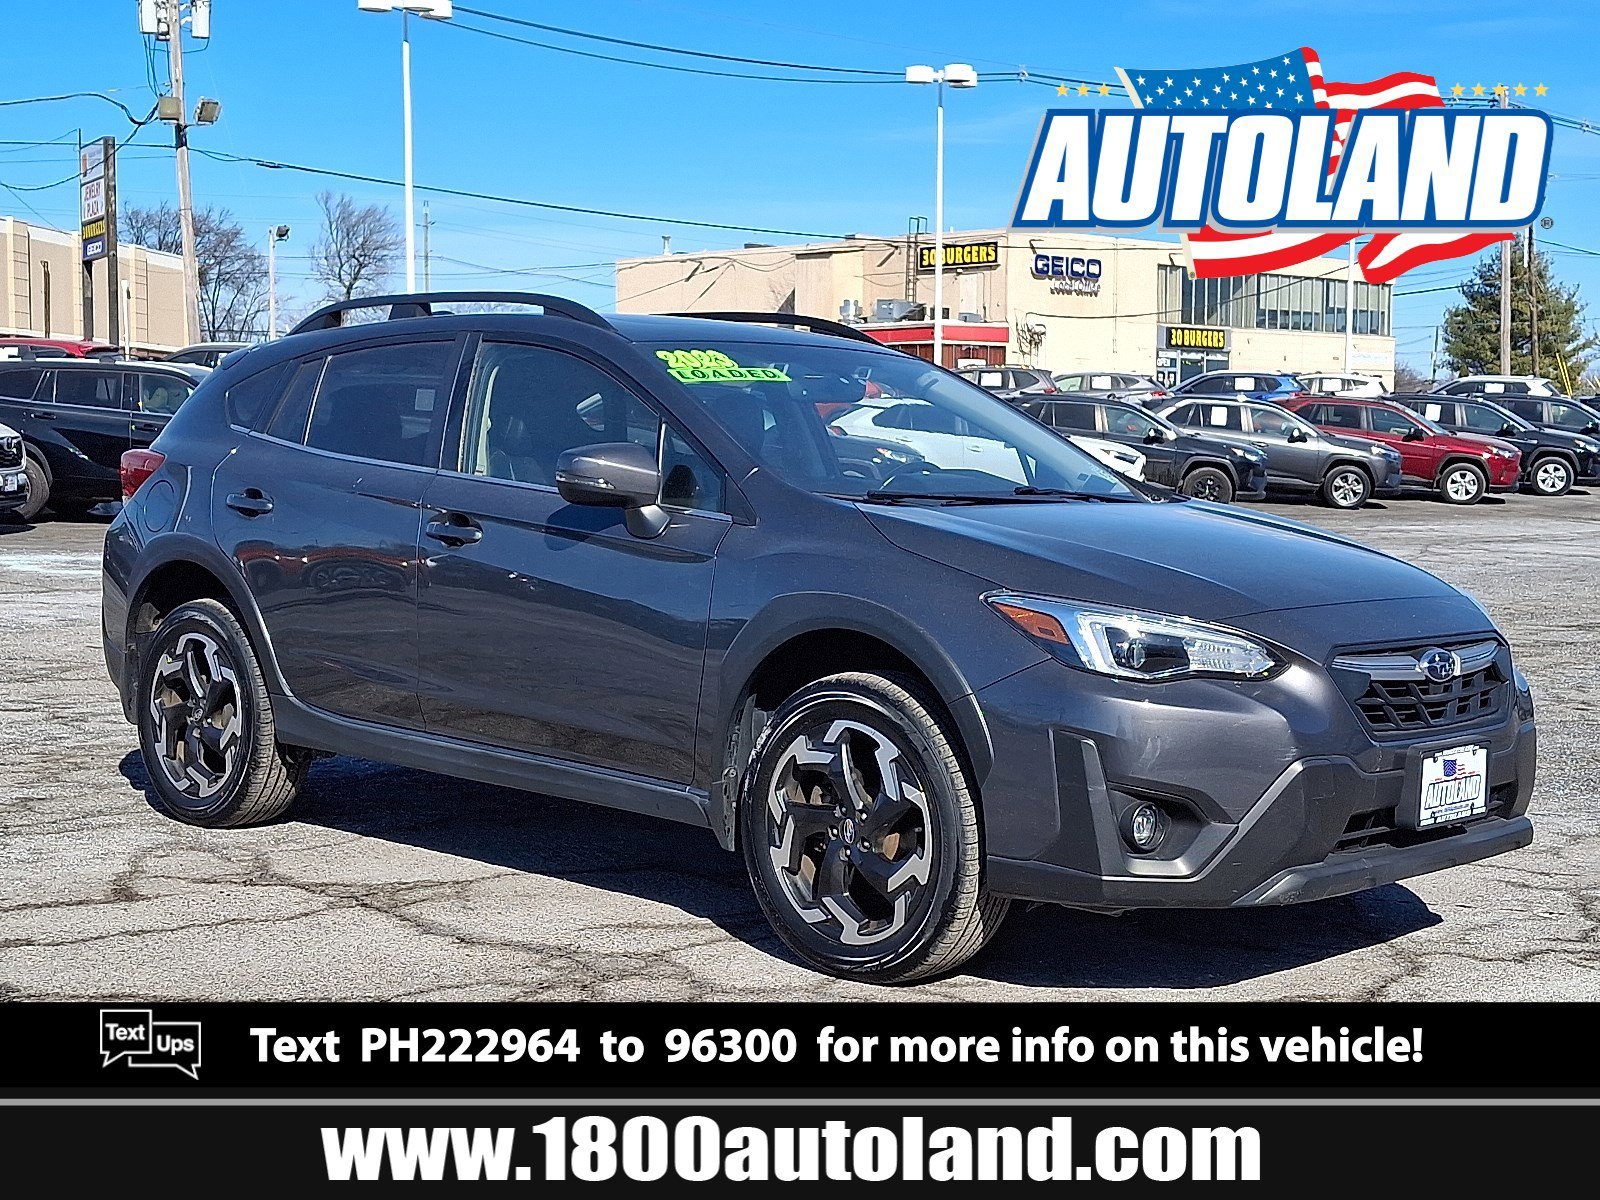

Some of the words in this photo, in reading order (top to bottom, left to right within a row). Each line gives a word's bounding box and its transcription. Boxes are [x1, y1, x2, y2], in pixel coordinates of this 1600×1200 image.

[922, 248, 936, 266] 30
[1034, 254, 1102, 279] GEICO
[1171, 328, 1183, 346] 30
[1183, 329, 1225, 348] BURGERS
[675, 369, 781, 380] LOADED
[1424, 773, 1482, 811] AUTOLAND
